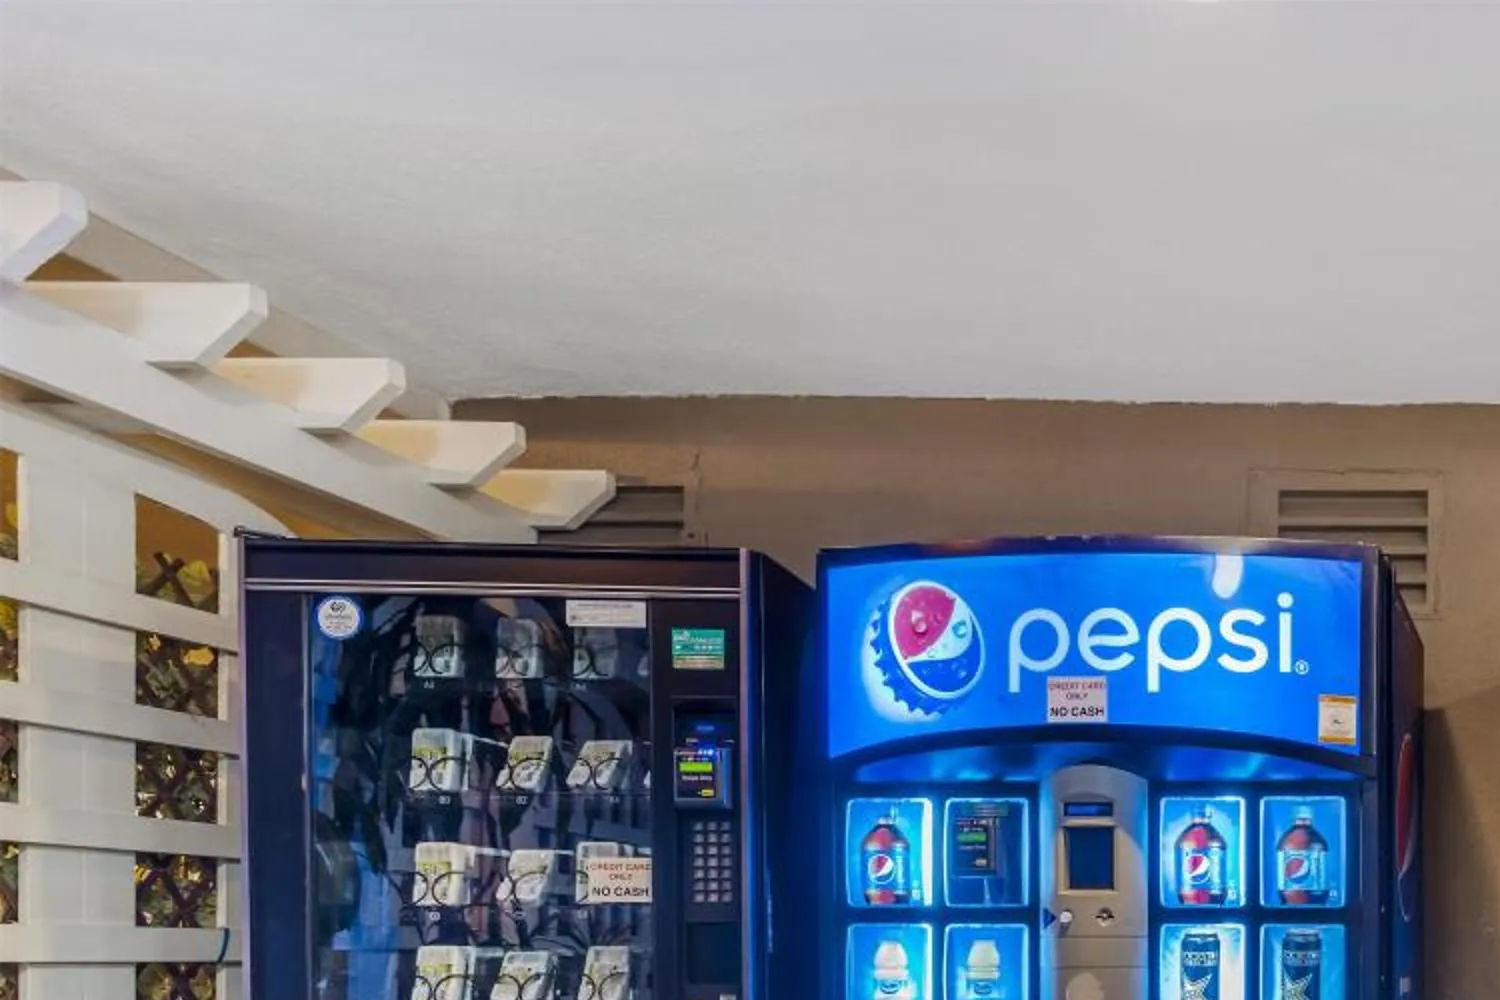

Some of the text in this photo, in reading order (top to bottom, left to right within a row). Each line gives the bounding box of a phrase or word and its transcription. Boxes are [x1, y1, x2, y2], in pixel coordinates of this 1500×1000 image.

[1009, 592, 1293, 693] pepsi
[1050, 706, 1104, 717] NO CASH
[592, 887, 649, 897] NO CASH
